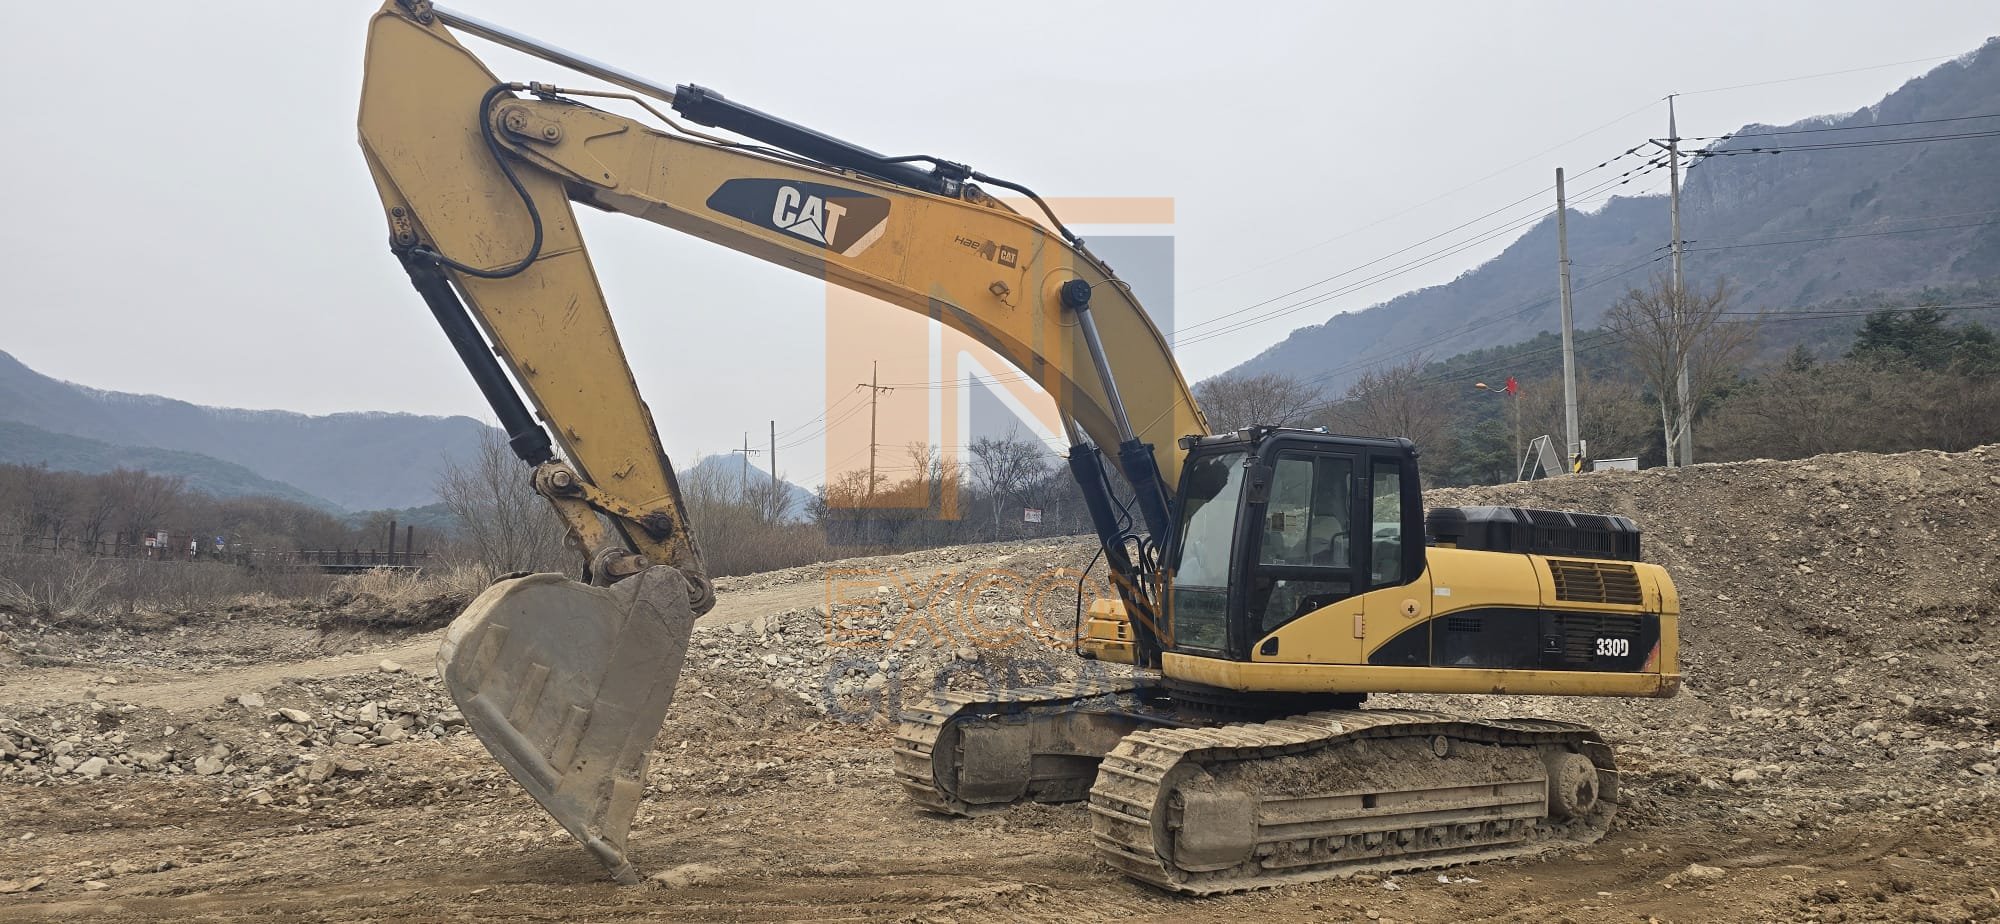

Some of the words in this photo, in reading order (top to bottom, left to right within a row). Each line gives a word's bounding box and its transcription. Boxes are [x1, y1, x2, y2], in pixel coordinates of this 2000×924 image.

[772, 185, 847, 246] CAT
[1000, 249, 1017, 264] CAT
[1596, 637, 1629, 657] 330D
